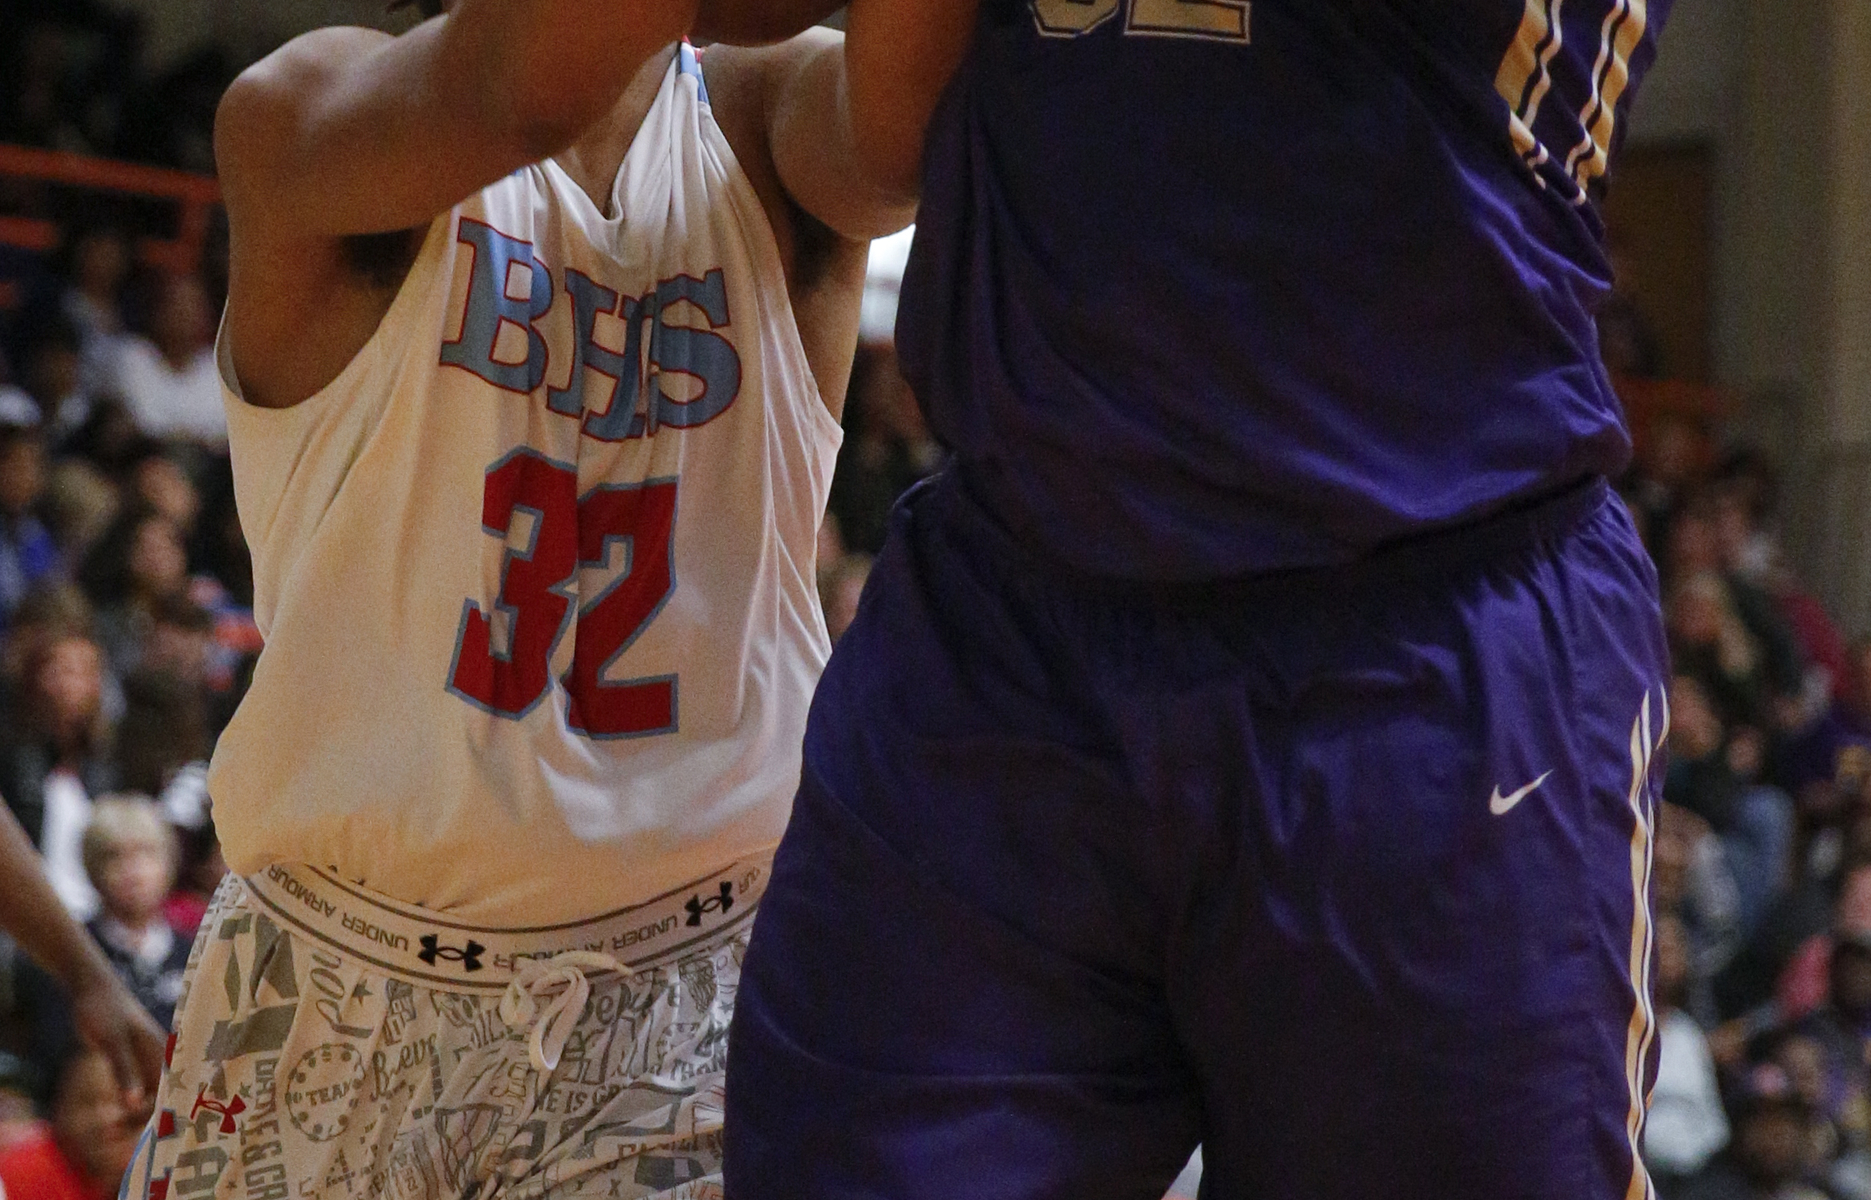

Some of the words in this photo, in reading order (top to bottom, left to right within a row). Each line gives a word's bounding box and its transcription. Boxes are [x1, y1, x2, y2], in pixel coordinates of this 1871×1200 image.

[440, 216, 742, 442] BHS
[445, 445, 680, 740] 32
[268, 864, 336, 918] ARMOUR
[341, 912, 409, 951] UNDER
[611, 915, 678, 951] UNDER
